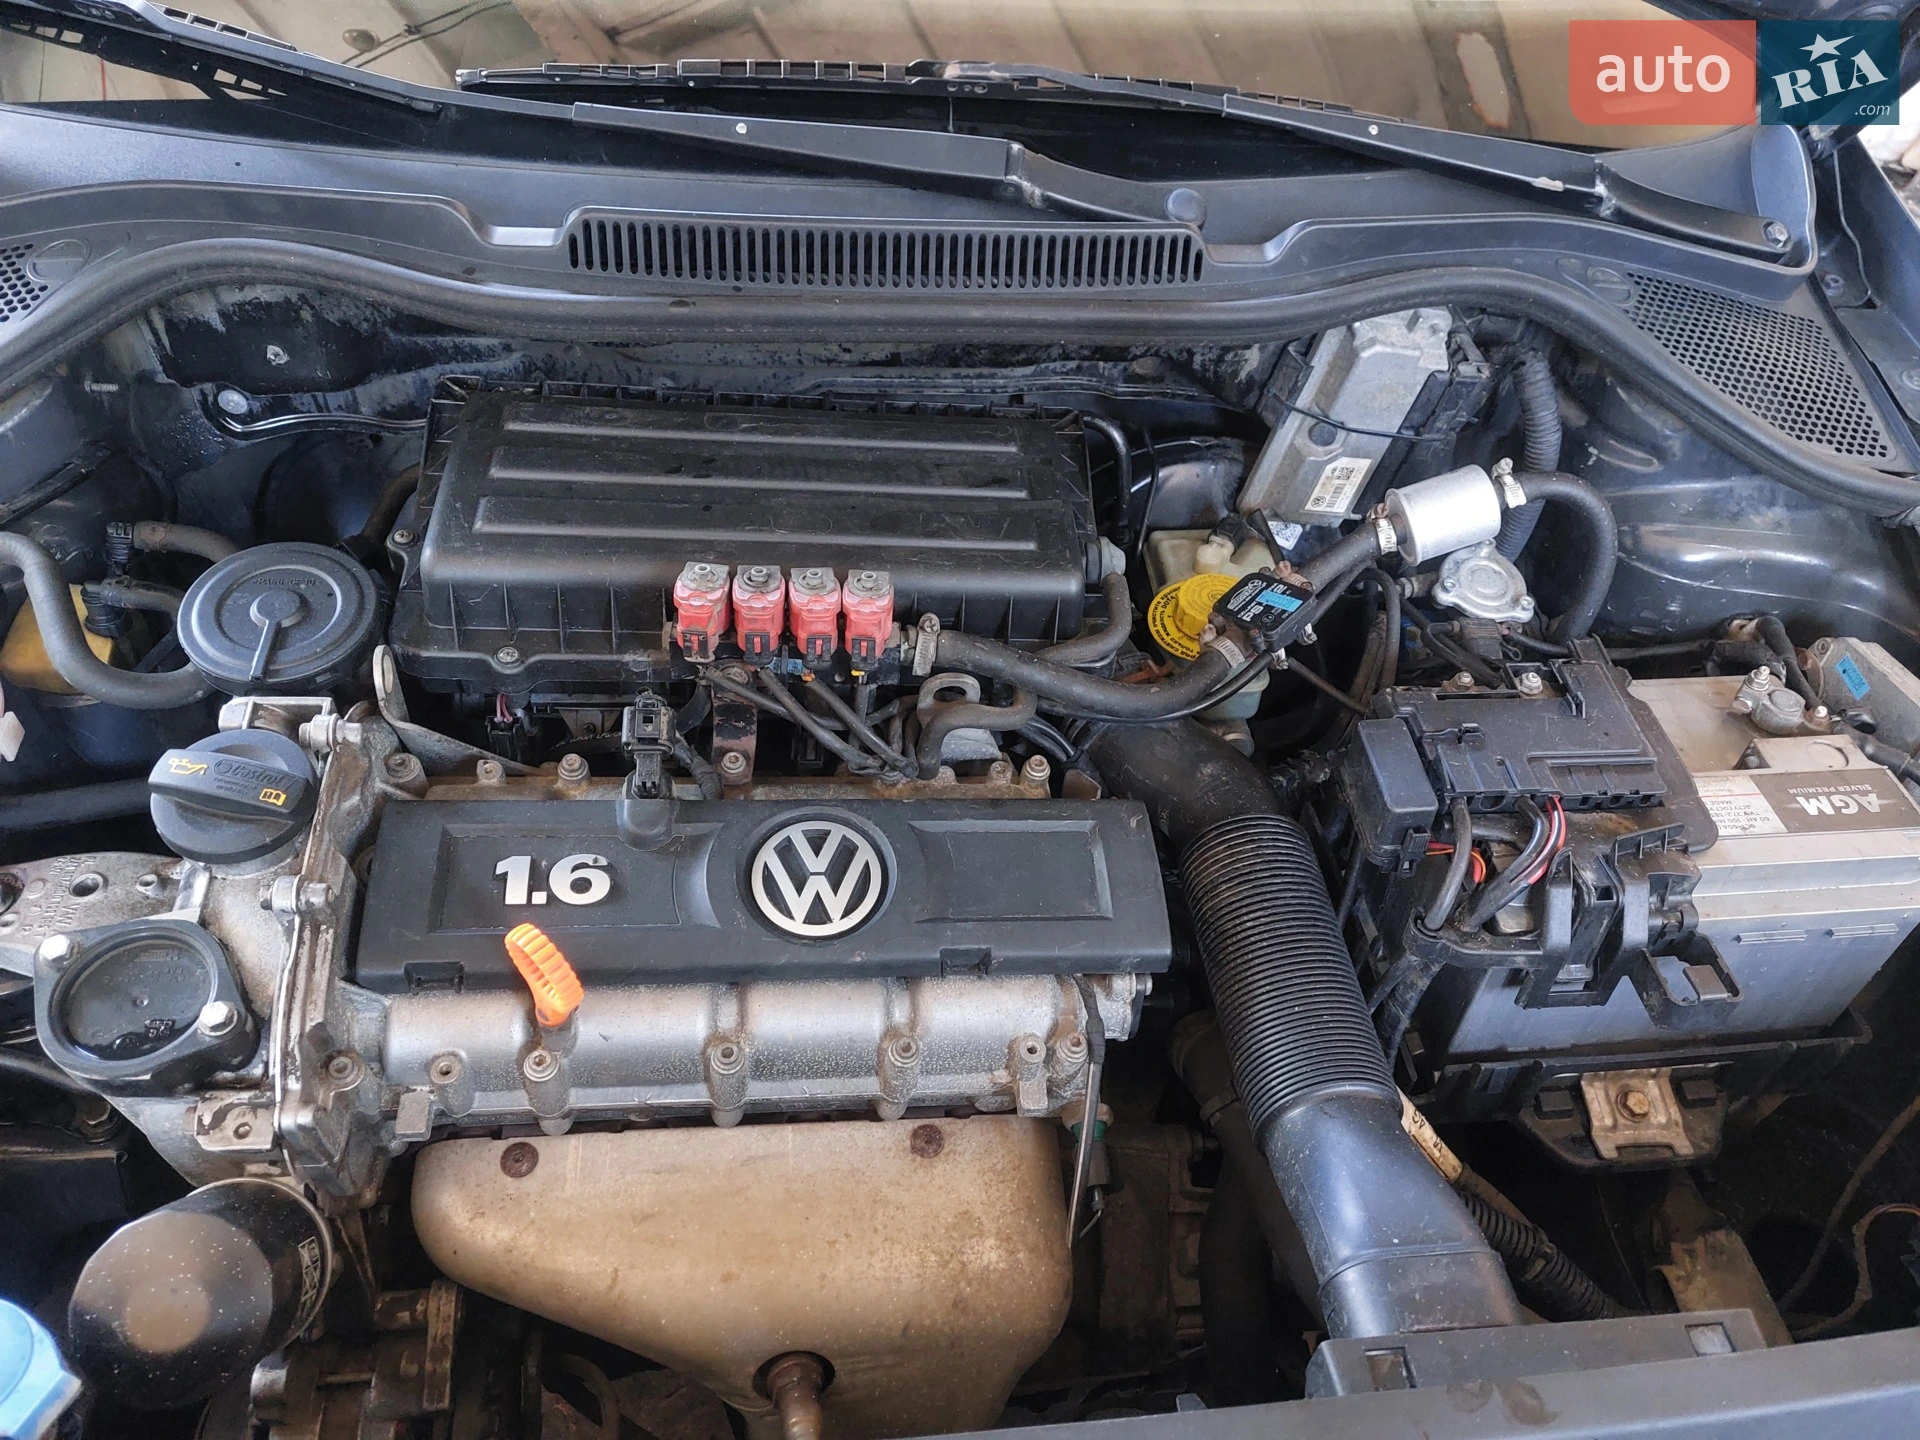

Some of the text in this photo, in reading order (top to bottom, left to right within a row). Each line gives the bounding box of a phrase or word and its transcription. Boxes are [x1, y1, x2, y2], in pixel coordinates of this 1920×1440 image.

[232, 763, 284, 786] Castrol
[1787, 784, 1873, 794] SILVER PREMIUM
[1795, 792, 1881, 816] AGM
[495, 853, 612, 905] 1.6
[751, 820, 882, 937] VW
